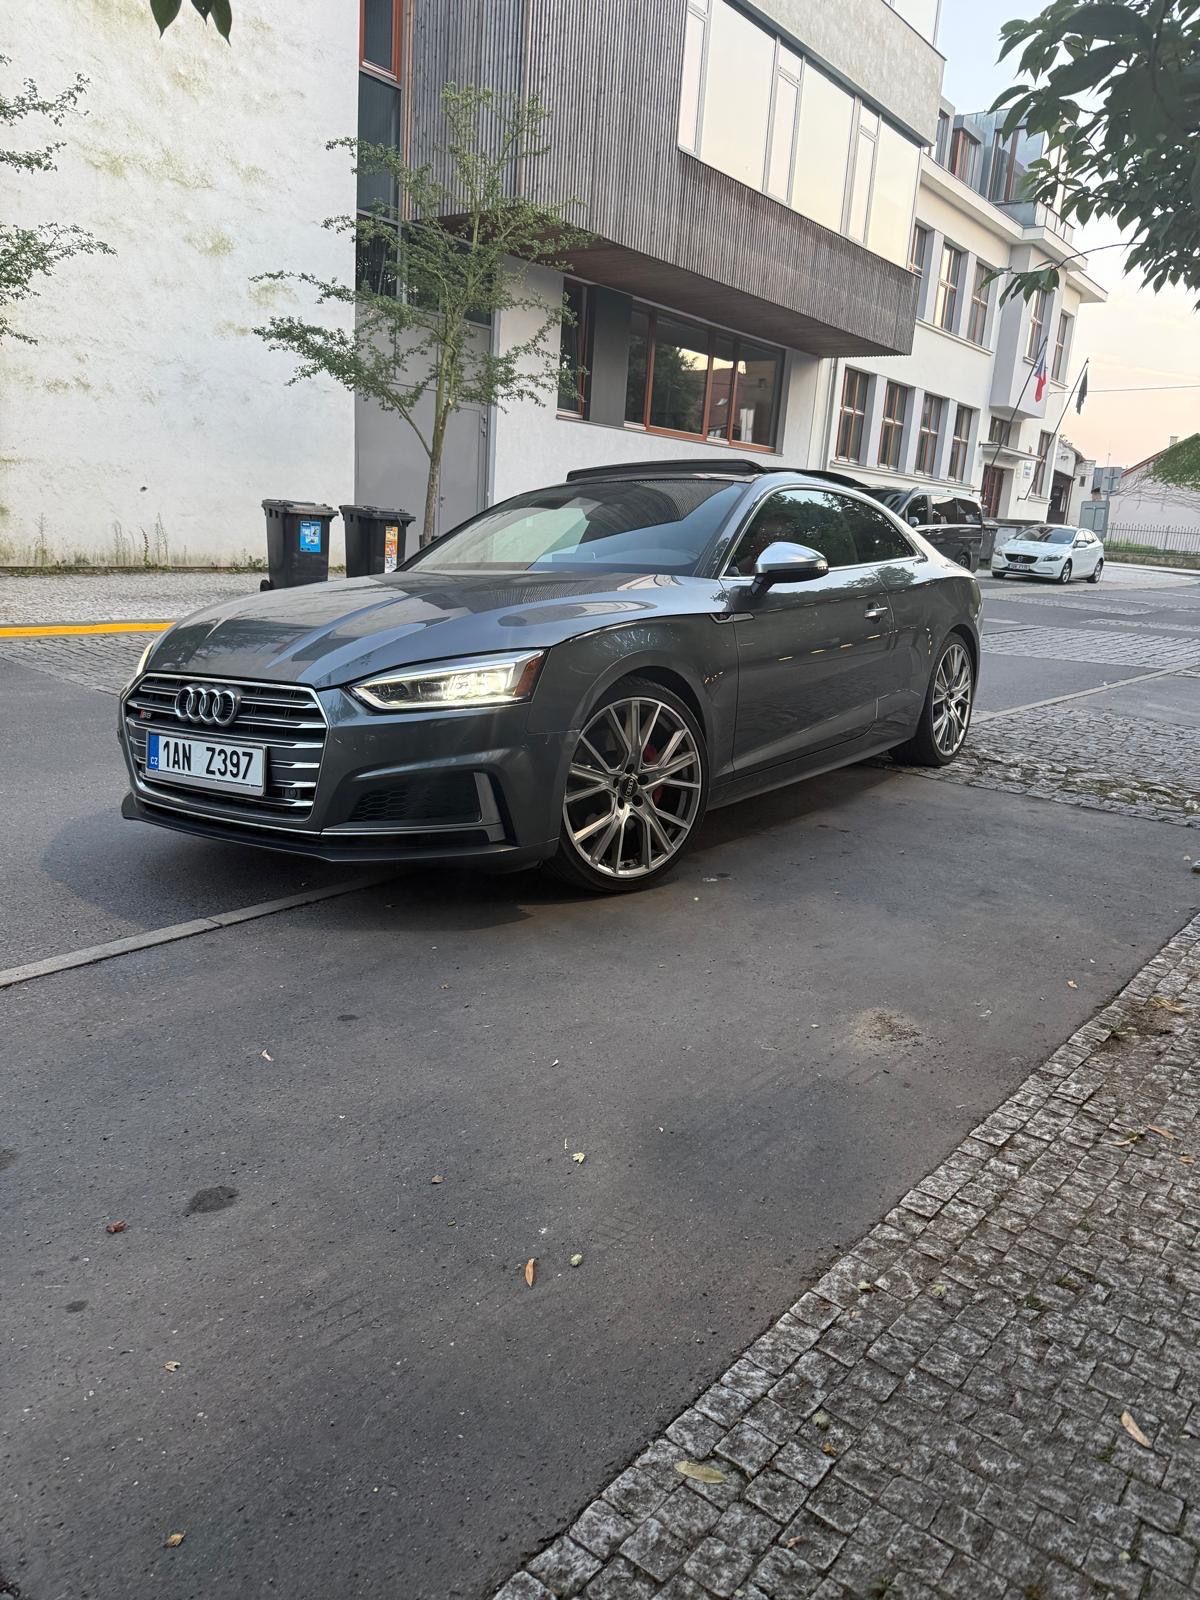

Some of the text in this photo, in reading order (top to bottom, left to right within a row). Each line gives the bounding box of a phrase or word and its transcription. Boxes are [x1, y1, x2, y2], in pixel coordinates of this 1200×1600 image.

[150, 756, 158, 765] CZ
[163, 740, 254, 780] 1AN Z397
